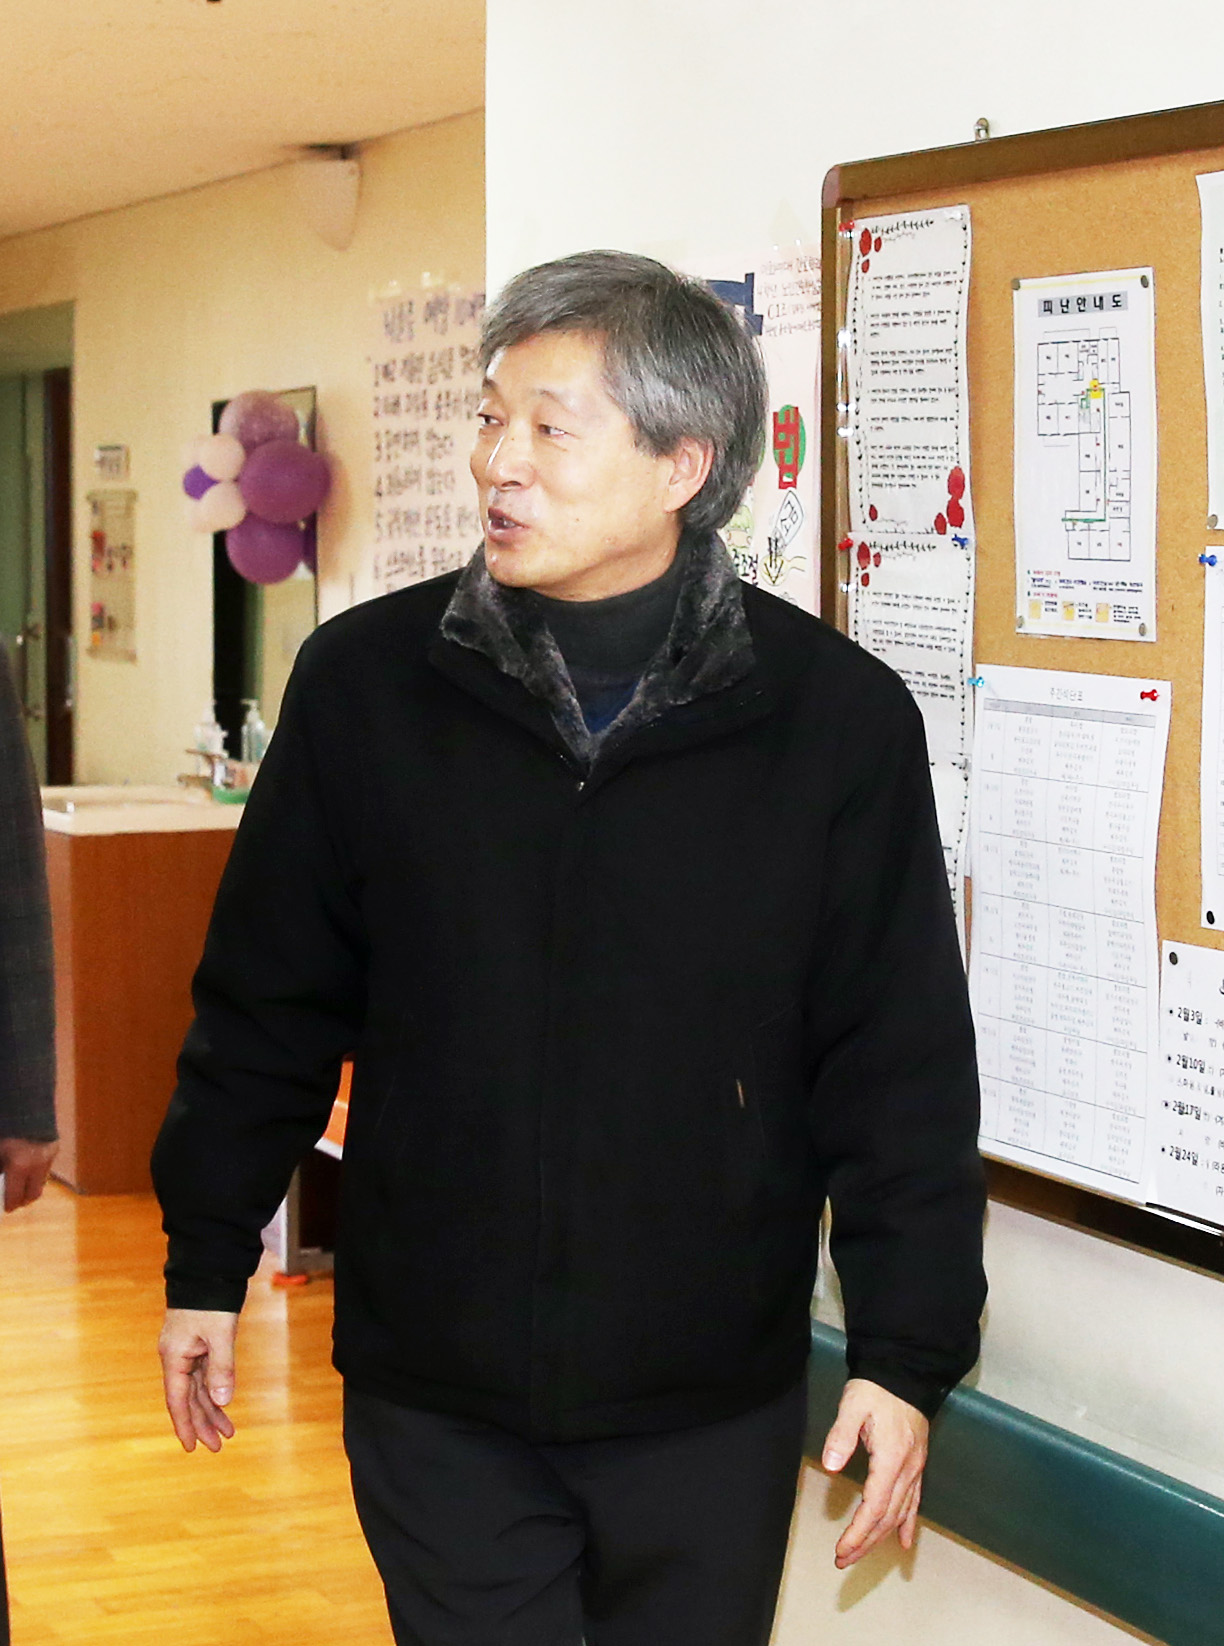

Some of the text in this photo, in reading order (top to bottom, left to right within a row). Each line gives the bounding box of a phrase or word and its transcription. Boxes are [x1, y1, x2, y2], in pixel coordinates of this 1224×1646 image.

[1042, 293, 1123, 315] 피난안내도
[1177, 1006, 1203, 1026] 2월3일
[1176, 1053, 1206, 1074] 2월10일
[1169, 1145, 1199, 1166] 2월24일
